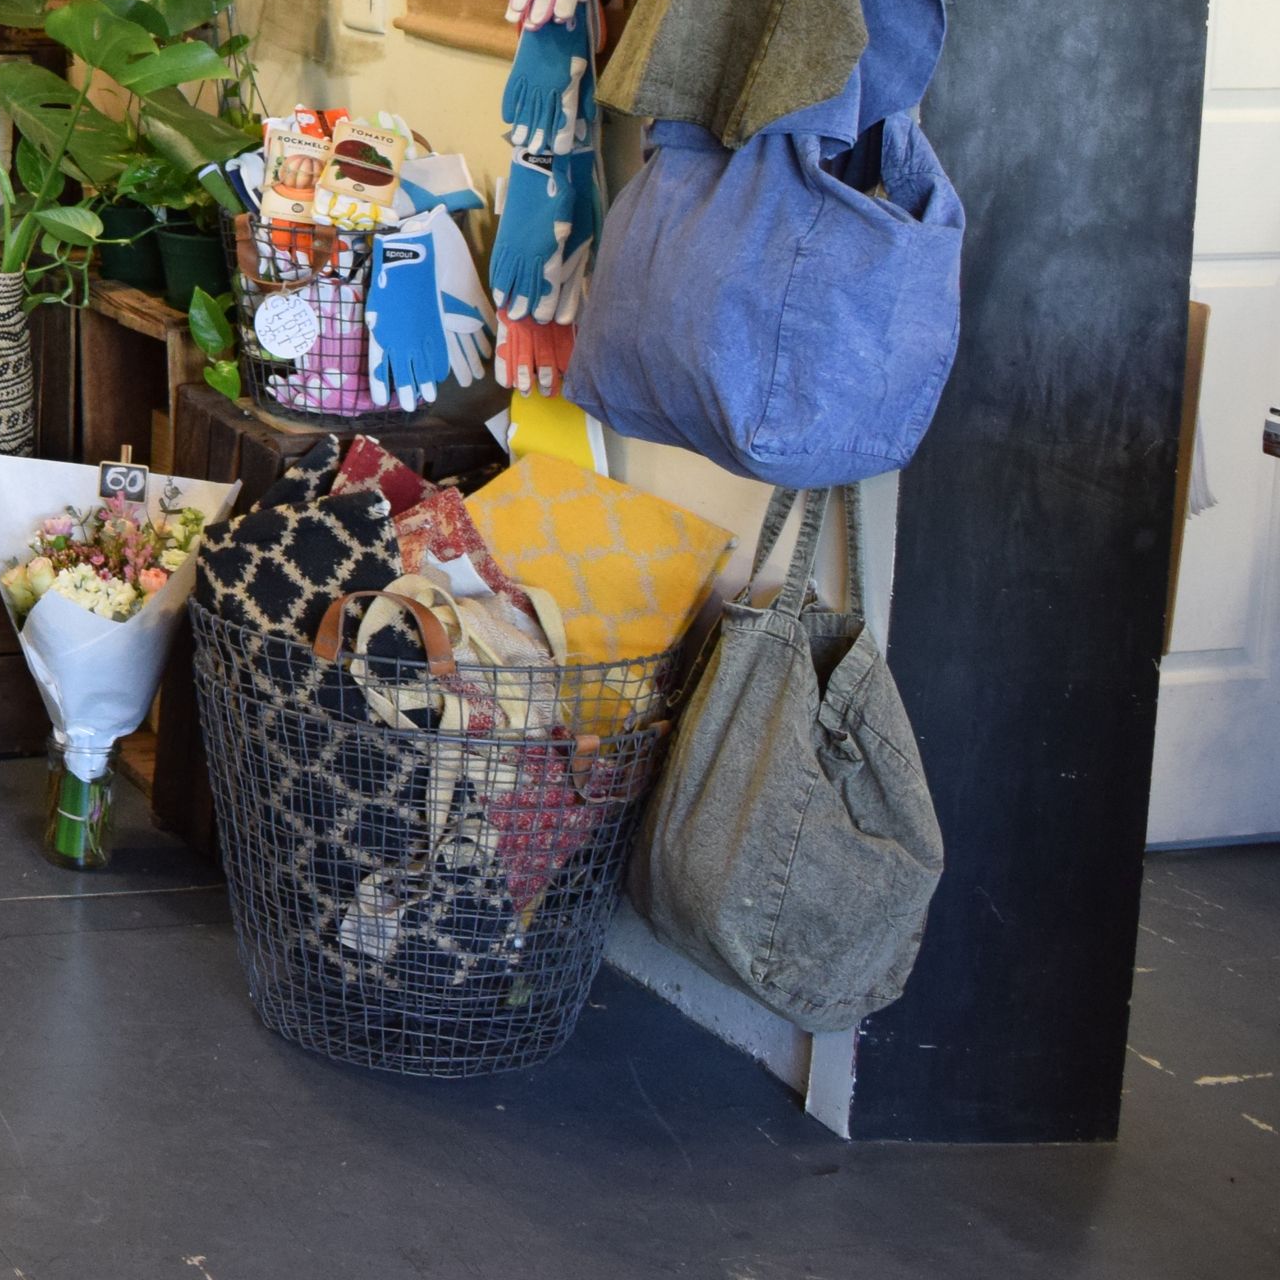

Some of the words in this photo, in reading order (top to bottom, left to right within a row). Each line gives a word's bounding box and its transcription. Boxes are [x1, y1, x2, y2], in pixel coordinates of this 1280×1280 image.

[277, 135, 330, 151] ROCKMELO
[351, 128, 394, 144] TOMATO
[385, 250, 414, 261] sprout
[105, 466, 145, 493] 60
